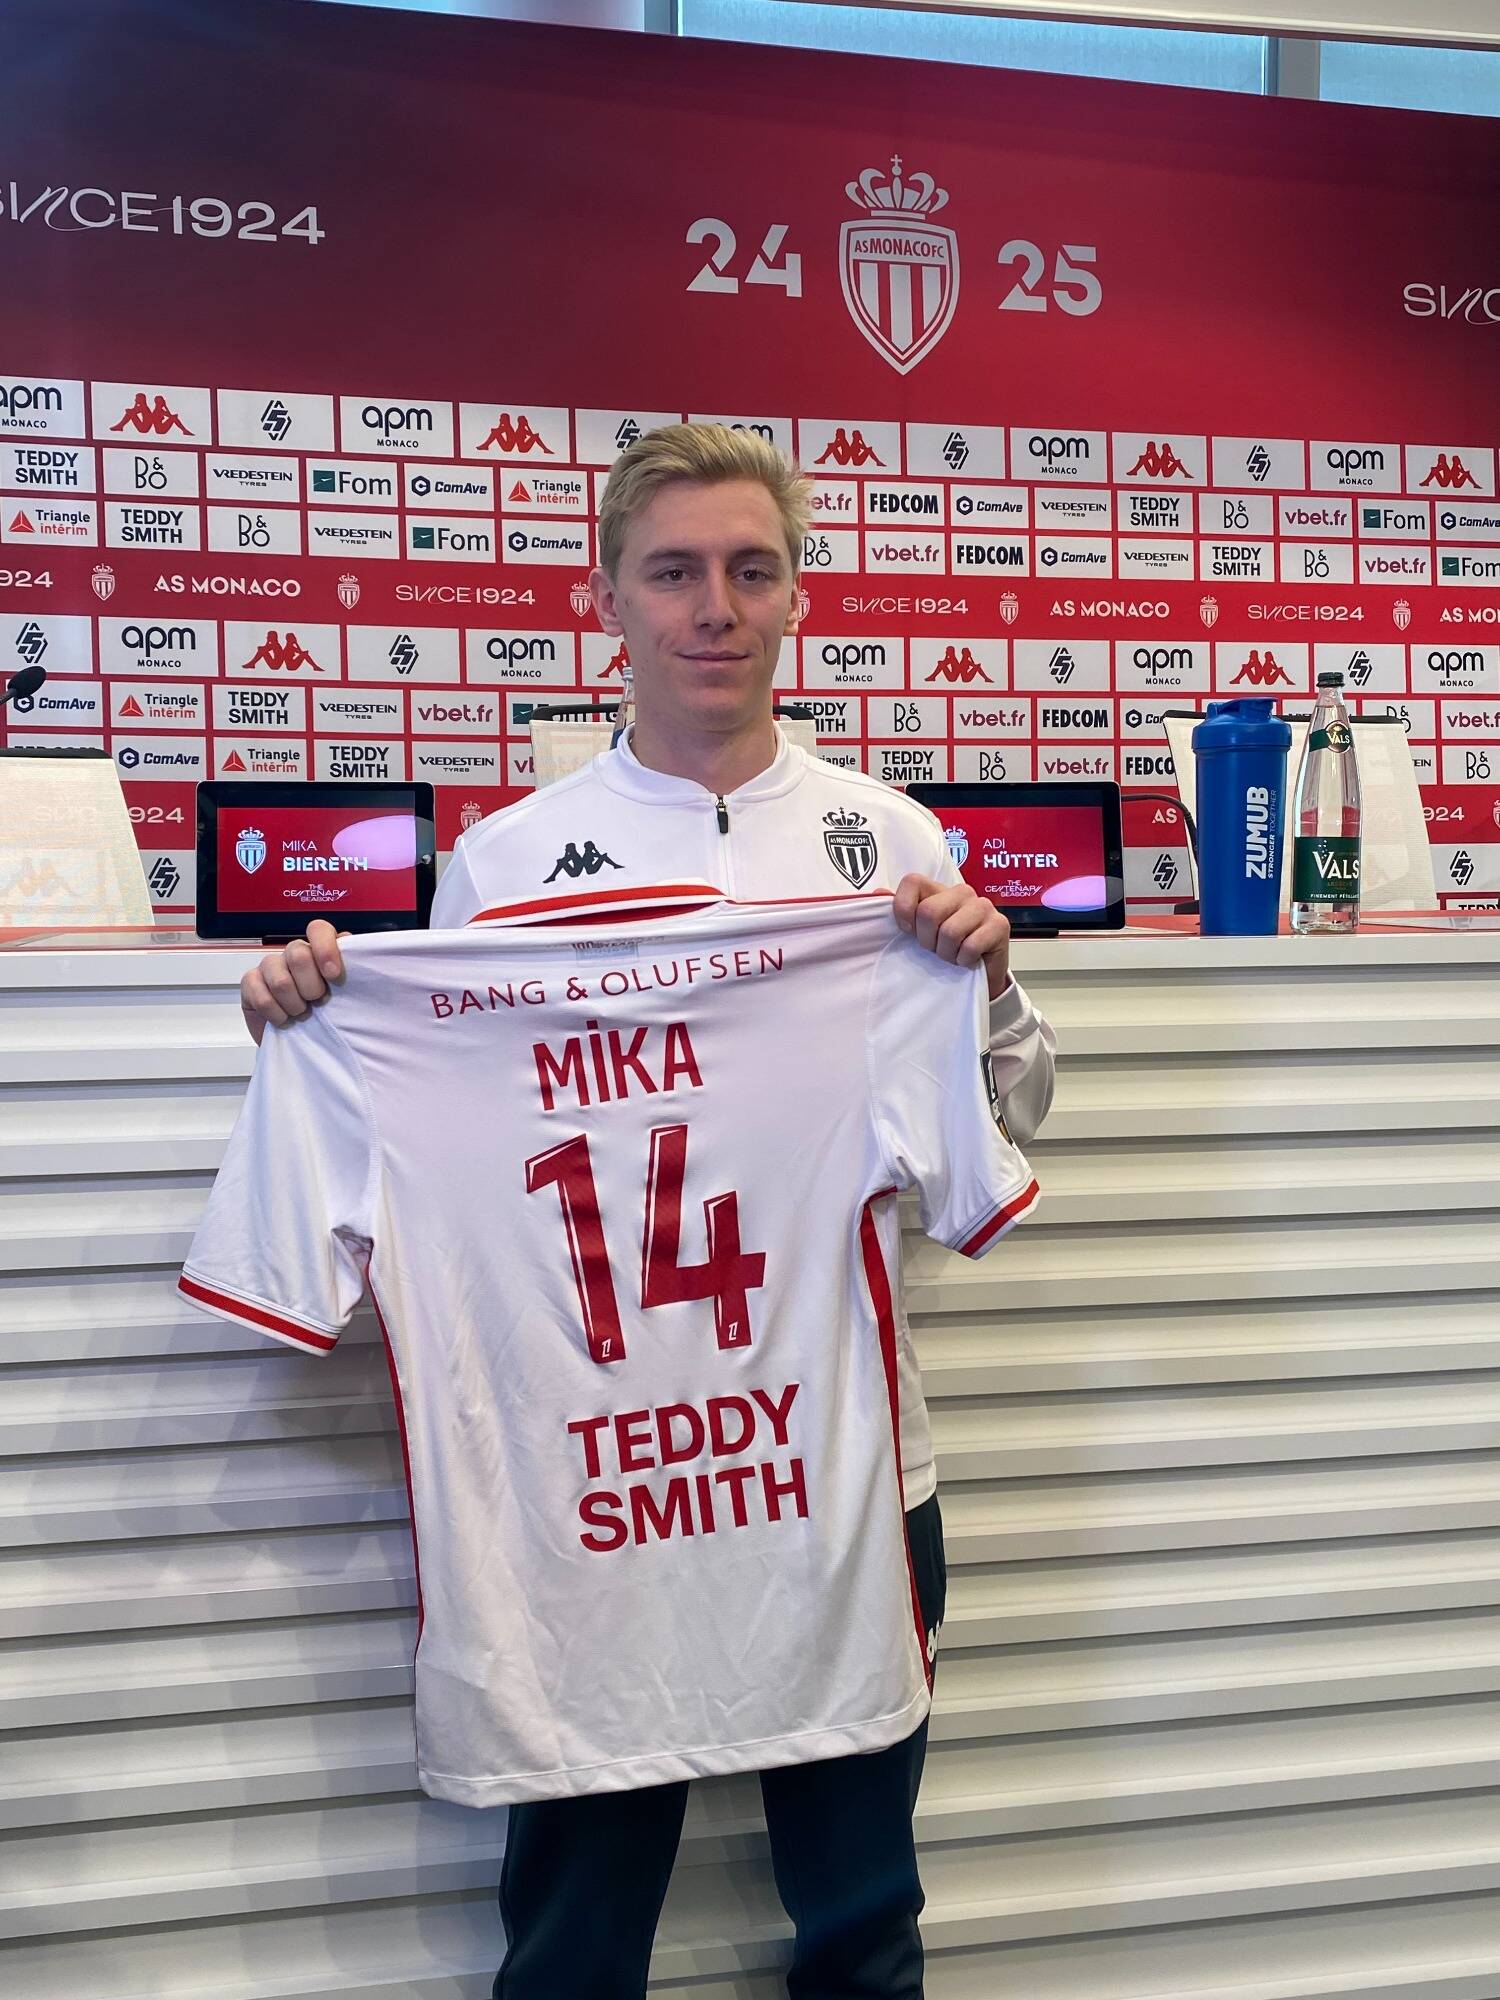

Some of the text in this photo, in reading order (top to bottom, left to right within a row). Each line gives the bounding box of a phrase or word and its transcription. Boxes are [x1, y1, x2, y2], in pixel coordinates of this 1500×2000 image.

[173, 196, 325, 244] 1924
[685, 217, 802, 297] 24
[998, 239, 1103, 316] 25
[2, 418, 47, 428] MONACO
[362, 405, 433, 439] apm
[377, 439, 419, 449] MONACO
[1029, 436, 1089, 465] apm
[15, 450, 78, 467] TEDDY
[1327, 448, 1384, 476] apm
[15, 468, 78, 486] SMITH
[213, 469, 293, 481] VREDESTEIN
[1042, 466, 1078, 475] MONACO
[339, 471, 392, 495] Fom
[435, 481, 487, 494] ComAve
[532, 480, 582, 494] Triangle
[1339, 478, 1373, 486] MONACO
[536, 492, 579, 505] intérim
[870, 493, 939, 514] FEDCOM
[1041, 501, 1107, 512] VREDESTEIN
[1130, 497, 1180, 511] TEDDY
[976, 501, 1023, 513] ComAve
[35, 510, 91, 525] Triangle
[121, 509, 183, 526] TEDDY
[1130, 513, 1179, 527] SMITH
[1285, 509, 1347, 527] vbet.fr
[1384, 510, 1425, 530] Fom
[40, 522, 88, 536] intérim
[121, 526, 183, 543] SMITH
[315, 528, 392, 540] VREDESTEIN
[439, 528, 489, 551] Fom
[531, 537, 583, 550] ComAve
[872, 544, 939, 562] vbet.fr
[956, 545, 1024, 566] FEDCOM
[1061, 552, 1107, 564] ComAve
[1124, 552, 1189, 562] VREDESTEIN
[1212, 547, 1262, 561] TEDDY
[1212, 562, 1261, 576] SMITH
[1365, 558, 1426, 574] vbet.fr
[1462, 557, 1500, 577] Fom
[154, 575, 301, 597] AS MONACO
[476, 588, 535, 605] 1924
[915, 598, 968, 614] 1924
[1050, 601, 1170, 618] AS MONACO
[1314, 606, 1364, 621] 1924
[1440, 607, 1500, 623] AS MO
[121, 626, 195, 657] apm
[486, 637, 555, 668] apm
[822, 644, 885, 673] apm
[137, 659, 181, 668] MONACO
[1133, 649, 1193, 676] apm
[1428, 652, 1484, 678] apm
[501, 669, 542, 678] MONACO
[38, 697, 95, 710] ComAve
[145, 694, 198, 708] Triangle
[228, 691, 289, 707] TEDDY
[149, 706, 196, 719] intérim
[228, 708, 288, 725] SMITH
[319, 703, 397, 714] VREDESTEIN
[418, 703, 493, 722] vbet.fr
[816, 719, 845, 732] ITH
[960, 710, 1025, 727] vbet.fr
[1042, 709, 1108, 728] FEDCOM
[144, 753, 199, 765] ComAve
[248, 749, 300, 763] Triangle
[330, 746, 389, 762] TEDDY
[418, 757, 494, 767] VREDESTEIN
[882, 752, 934, 765] TEDDY
[252, 761, 298, 773] intérim
[330, 763, 388, 778] SMITH
[882, 767, 933, 780] SMITH
[1044, 758, 1109, 775] vbet.fr
[1152, 808, 1177, 823] AS
[1246, 787, 1269, 879] ZUMUB
[282, 841, 317, 851] MIKA
[983, 839, 1005, 849] ADI
[283, 857, 368, 871] BIERETH
[983, 852, 1058, 868] HÜTTER
[1312, 851, 1359, 879] VALS
[431, 948, 784, 1018] BANG & OLUFSEN
[524, 1124, 766, 1364] 14
[567, 1384, 799, 1478] TEDDY
[578, 1458, 809, 1552] SMITH
